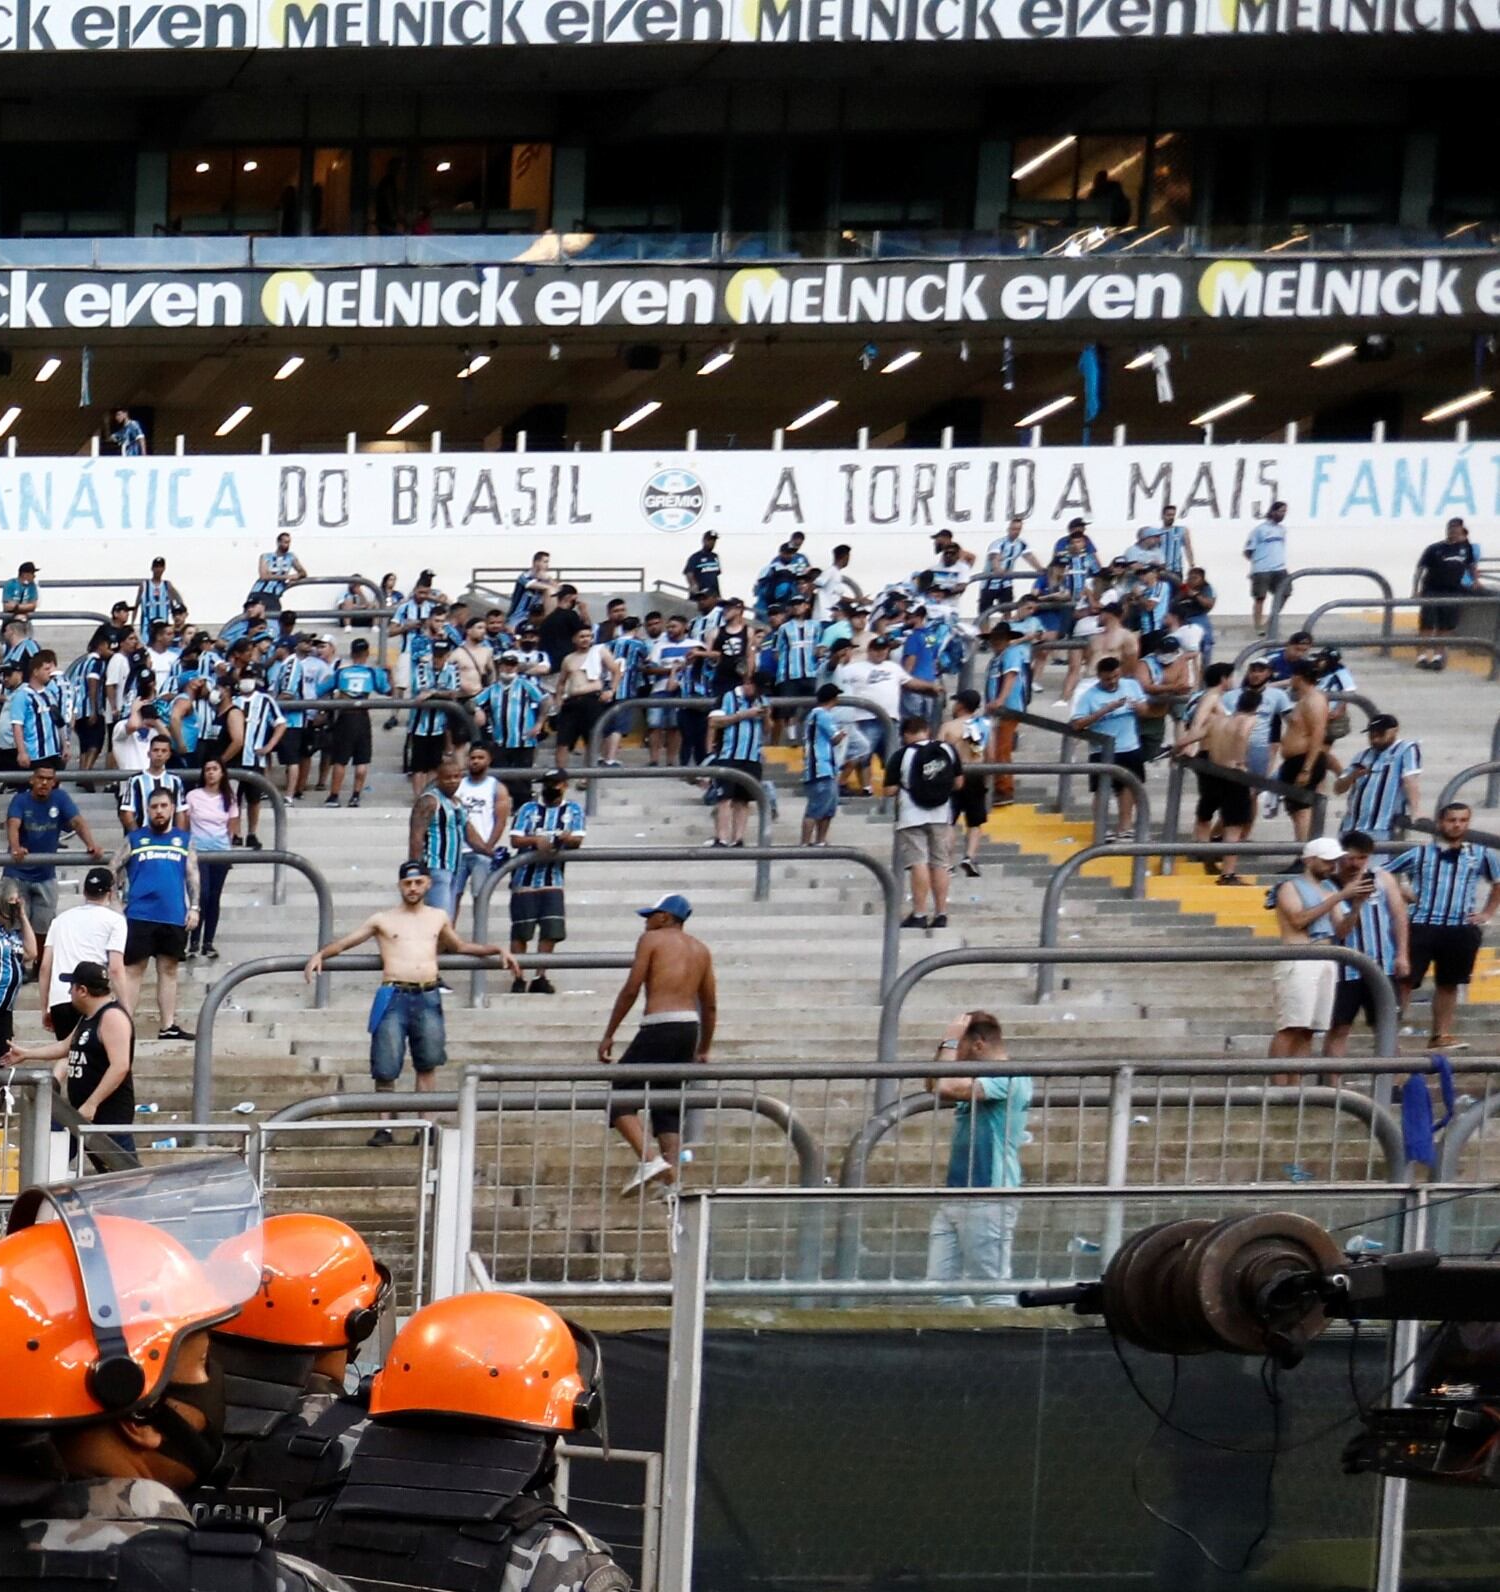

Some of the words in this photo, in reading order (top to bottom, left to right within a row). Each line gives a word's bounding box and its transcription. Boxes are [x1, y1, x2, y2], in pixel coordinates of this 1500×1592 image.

[72, 5, 246, 49] even
[547, 0, 722, 43] even
[1021, 0, 1196, 37] even
[65, 282, 242, 327] even
[535, 279, 714, 325] even
[1001, 273, 1182, 319] even
[278, 465, 349, 528] DO
[392, 464, 592, 529] BRASIL
[763, 466, 804, 524] A
[840, 458, 1093, 523] TORCIDA
[1128, 458, 1279, 520] MAIS
